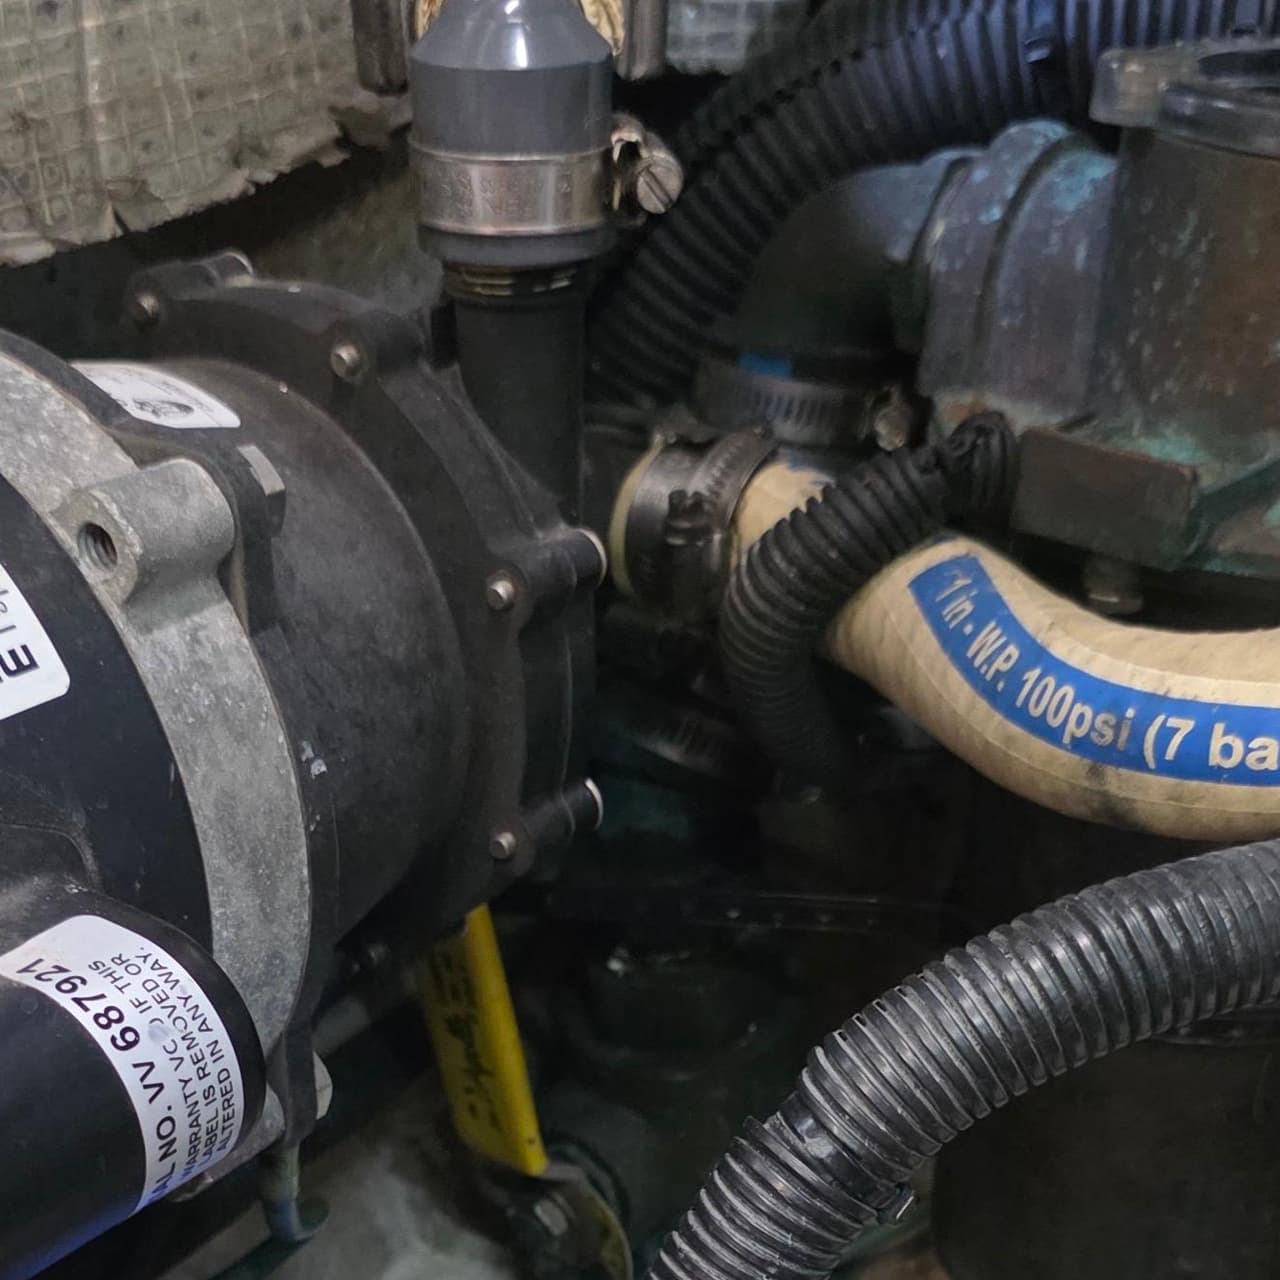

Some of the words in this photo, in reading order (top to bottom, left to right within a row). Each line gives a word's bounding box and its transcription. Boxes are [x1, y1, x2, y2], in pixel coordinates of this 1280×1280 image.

[935, 569, 972, 603] 1
[941, 590, 977, 630] in
[966, 621, 1020, 691] W.P.
[1016, 667, 1136, 752] 100psi
[1142, 714, 1195, 770] (7
[87, 960, 131, 994] THIS
[110, 952, 143, 976] OR
[135, 946, 181, 991] WAY.
[16, 958, 141, 1052] 687921
[129, 997, 153, 1014] IF
[177, 993, 214, 1035] ANY
[141, 978, 212, 1081] REMOVED
[206, 1040, 227, 1067] IN
[131, 1061, 165, 1105] VV
[202, 1084, 218, 1108] IS
[178, 1077, 202, 1178] WARRANTY
[215, 1067, 237, 1152] ALTERED
[156, 1104, 178, 1162] NO.
[199, 1107, 220, 1167] LABEL
